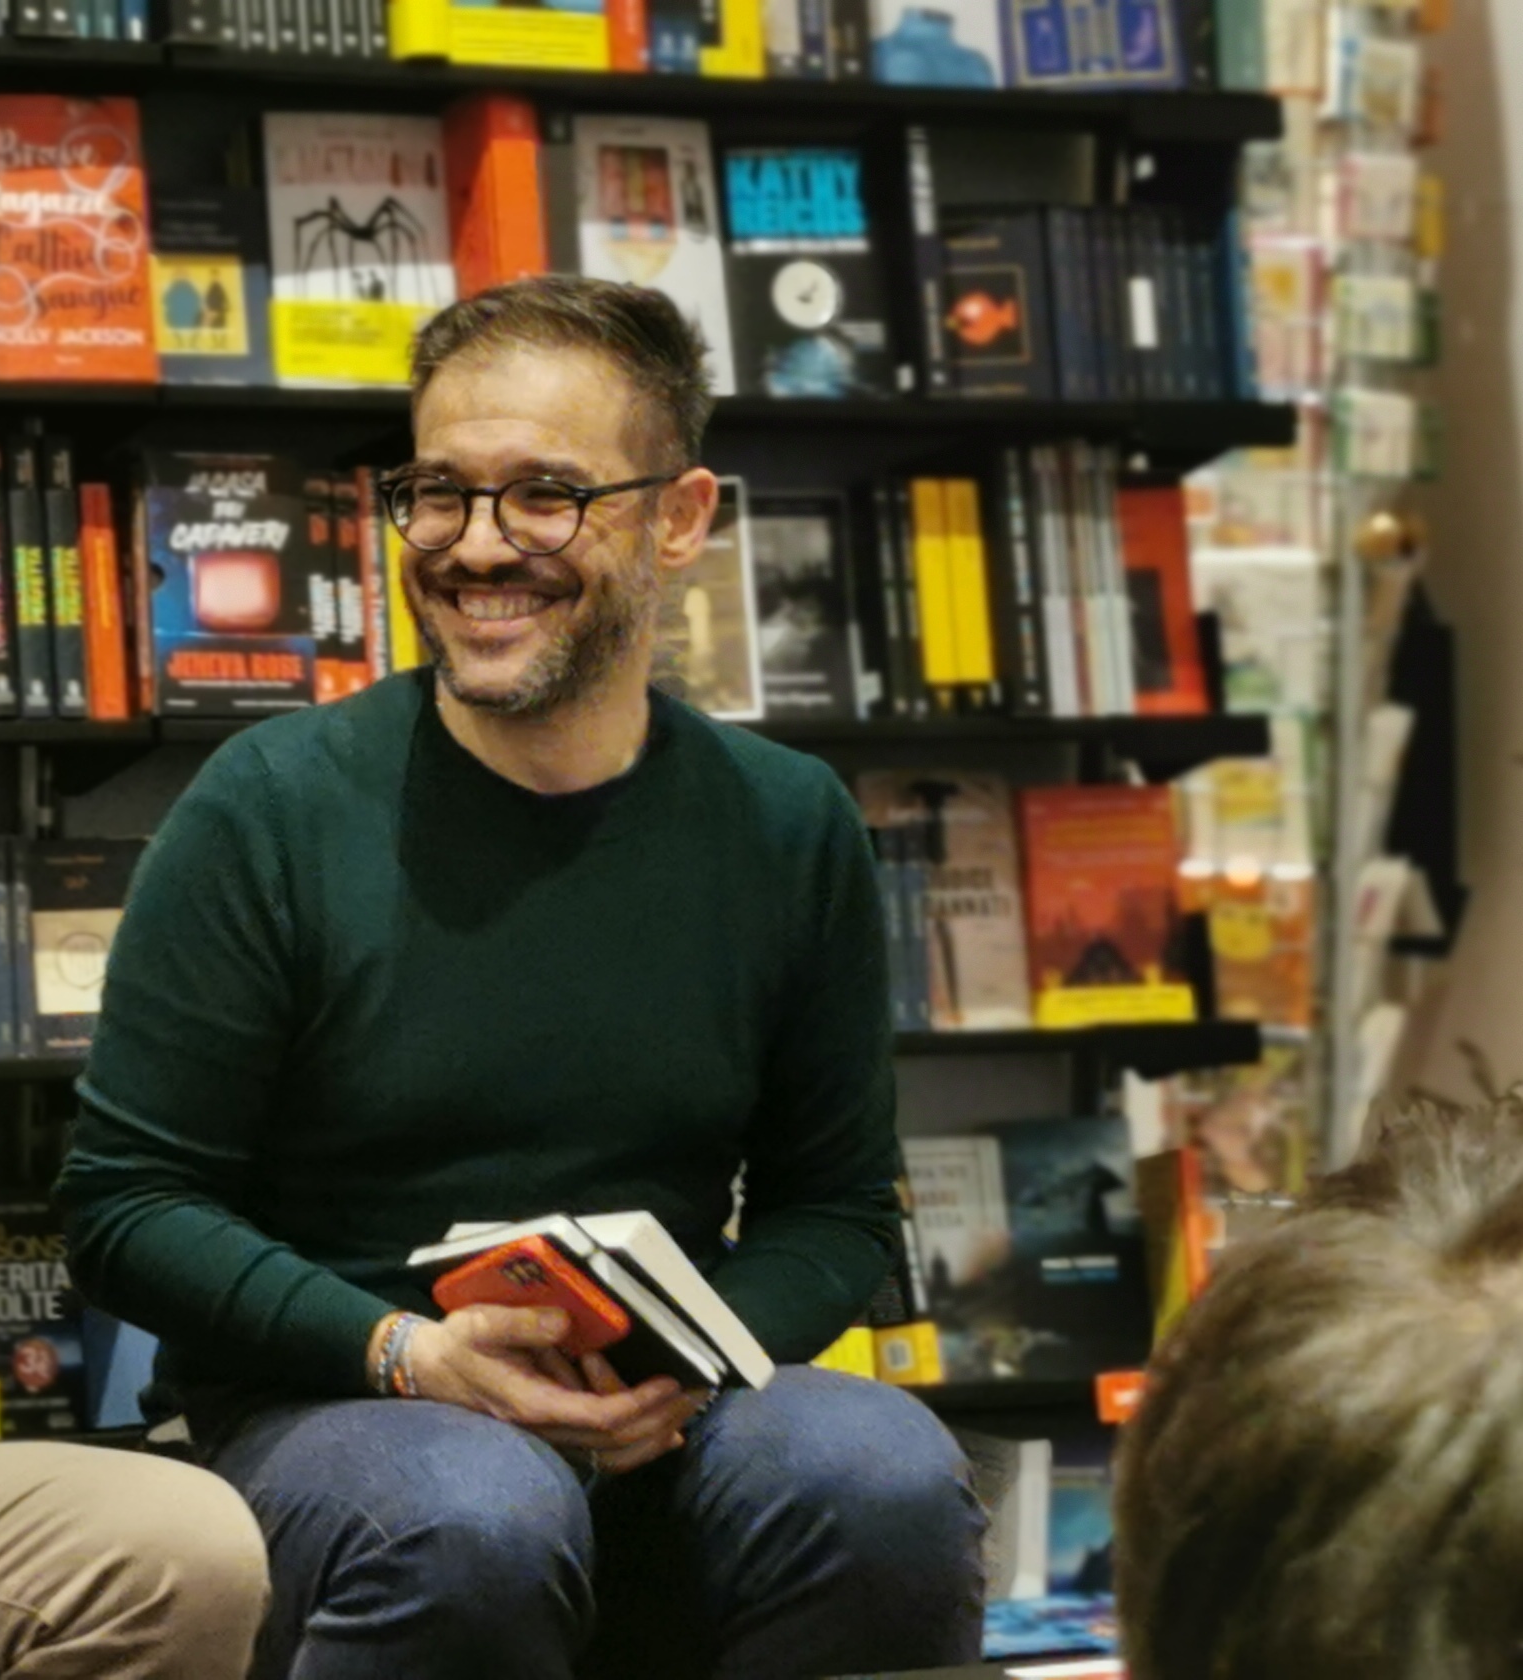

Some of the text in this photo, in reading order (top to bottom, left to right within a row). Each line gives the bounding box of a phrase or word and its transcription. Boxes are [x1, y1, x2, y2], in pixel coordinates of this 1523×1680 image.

[727, 151, 862, 199] KATHY
[57, 328, 145, 346] JACKSON
[208, 470, 269, 498] CASA
[169, 519, 291, 551] CADAVERI
